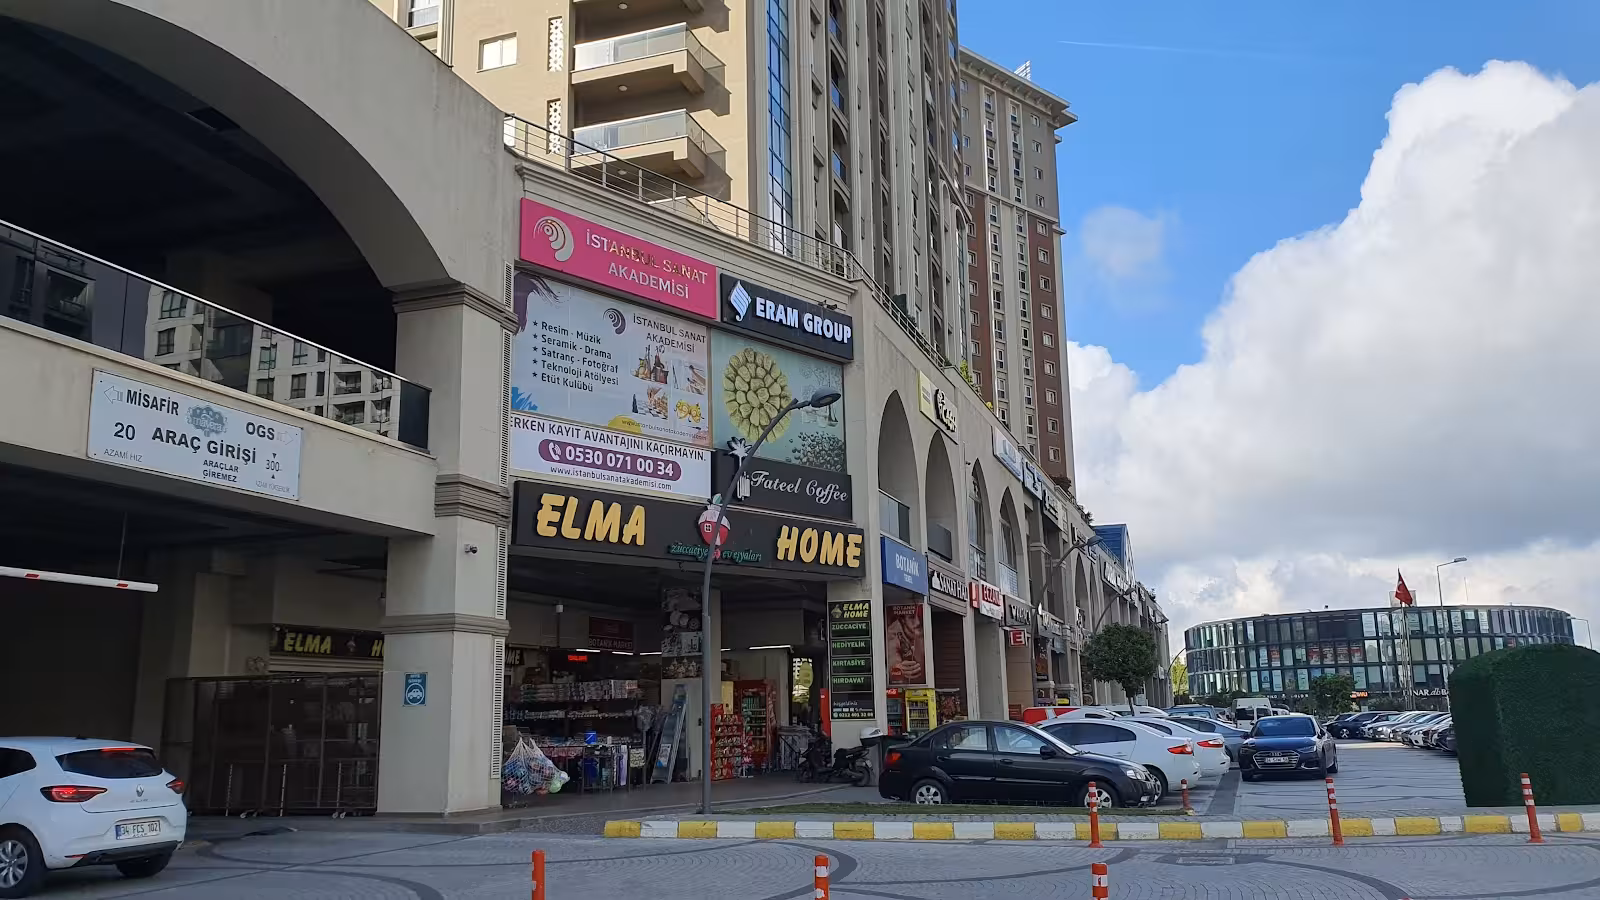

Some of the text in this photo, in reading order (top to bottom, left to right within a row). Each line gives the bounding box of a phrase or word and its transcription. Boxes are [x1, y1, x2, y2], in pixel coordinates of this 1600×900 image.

[586, 228, 708, 285] İSTANBUL SANAT
[608, 262, 688, 298] AKADEMİSİ
[541, 321, 601, 345] Resim Müzik
[633, 313, 706, 344] İSTANBUL SANAT
[756, 296, 852, 344] ERAM GROUP
[541, 334, 612, 360] Seramik Drama
[646, 333, 695, 353] AKADEMİSİ
[541, 347, 618, 374] Satranç Fotoğraf
[541, 359, 619, 386] Teknoloji Atölyesi
[541, 372, 593, 392] Etüt Kulübü
[126, 388, 180, 416] MİSAFİR
[114, 422, 256, 465] 20 ARAÇ GİRİŞİ
[246, 422, 275, 440] OGS
[549, 424, 582, 439] KAYIT
[584, 430, 643, 451] AVANTAJINI
[647, 442, 706, 461] KAÇIRMAYIN.
[104, 449, 143, 462] AZAMİ HIZ
[202, 460, 239, 473] ARAÇLAR
[266, 459, 280, 472] 300
[566, 446, 674, 477] 0530 071 00 34
[202, 468, 237, 483] GİREMEZ
[550, 466, 672, 491] www.istanbulsanatakademisi.com
[751, 470, 848, 504] Fateel Coffee
[536, 493, 863, 568] ELMA HOME
[283, 632, 332, 654] ELMA
[1012, 631, 1023, 644] E
[122, 823, 158, 835] 34 FCS 102
